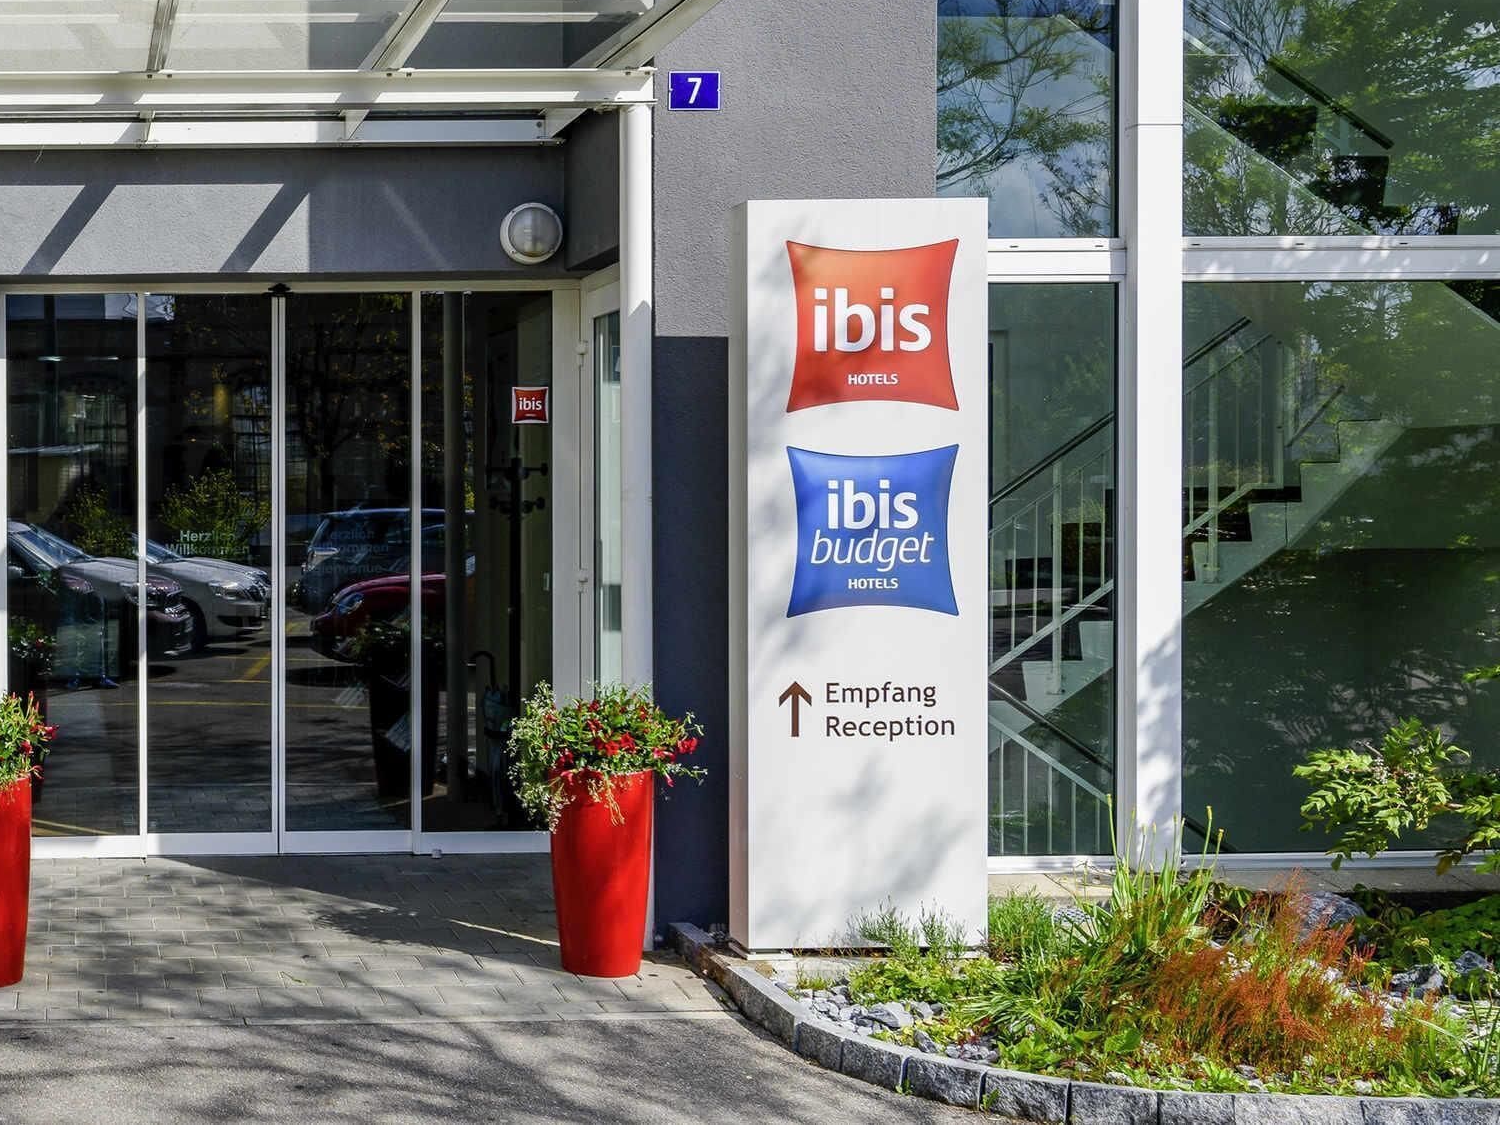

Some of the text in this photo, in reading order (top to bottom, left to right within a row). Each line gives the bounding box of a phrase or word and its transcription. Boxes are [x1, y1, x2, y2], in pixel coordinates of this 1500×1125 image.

[687, 78, 702, 105] 7
[813, 286, 932, 352] ibis
[847, 373, 899, 386] HOTELS
[518, 397, 543, 411] ibis
[827, 479, 919, 530] ibis
[811, 529, 934, 572] budget
[848, 577, 899, 590] HOTELS
[826, 682, 937, 708] Empfang
[826, 715, 955, 742] Reception
